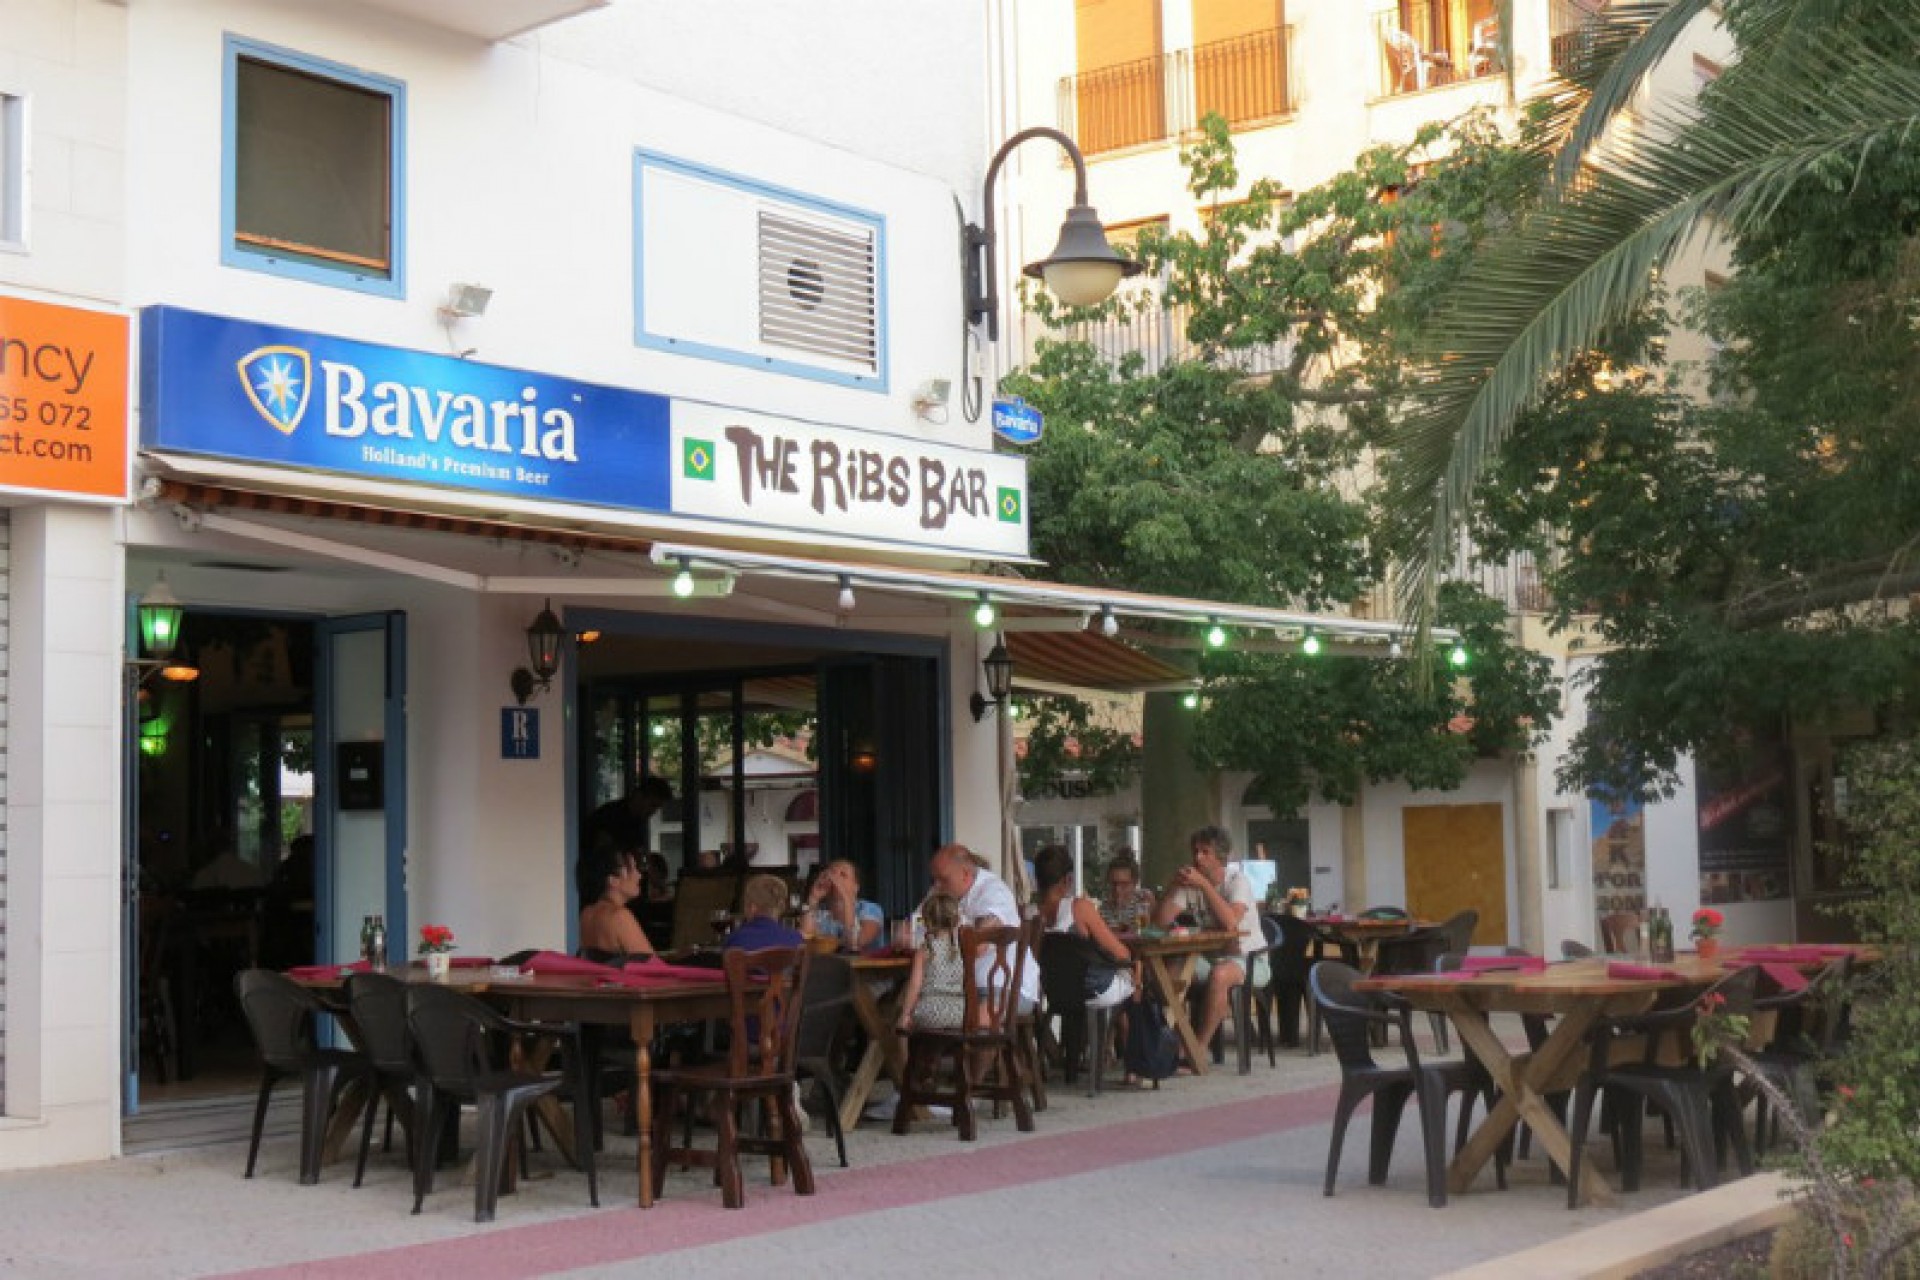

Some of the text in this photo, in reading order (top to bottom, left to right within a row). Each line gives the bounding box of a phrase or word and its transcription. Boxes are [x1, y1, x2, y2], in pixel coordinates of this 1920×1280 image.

[0, 336, 94, 395] ncy
[39, 400, 91, 431] 072
[321, 359, 579, 462] Bavaria
[361, 446, 550, 486] Holland's Premium Beer
[724, 424, 798, 505] THE
[919, 456, 990, 529] BAR
[513, 710, 528, 740] R
